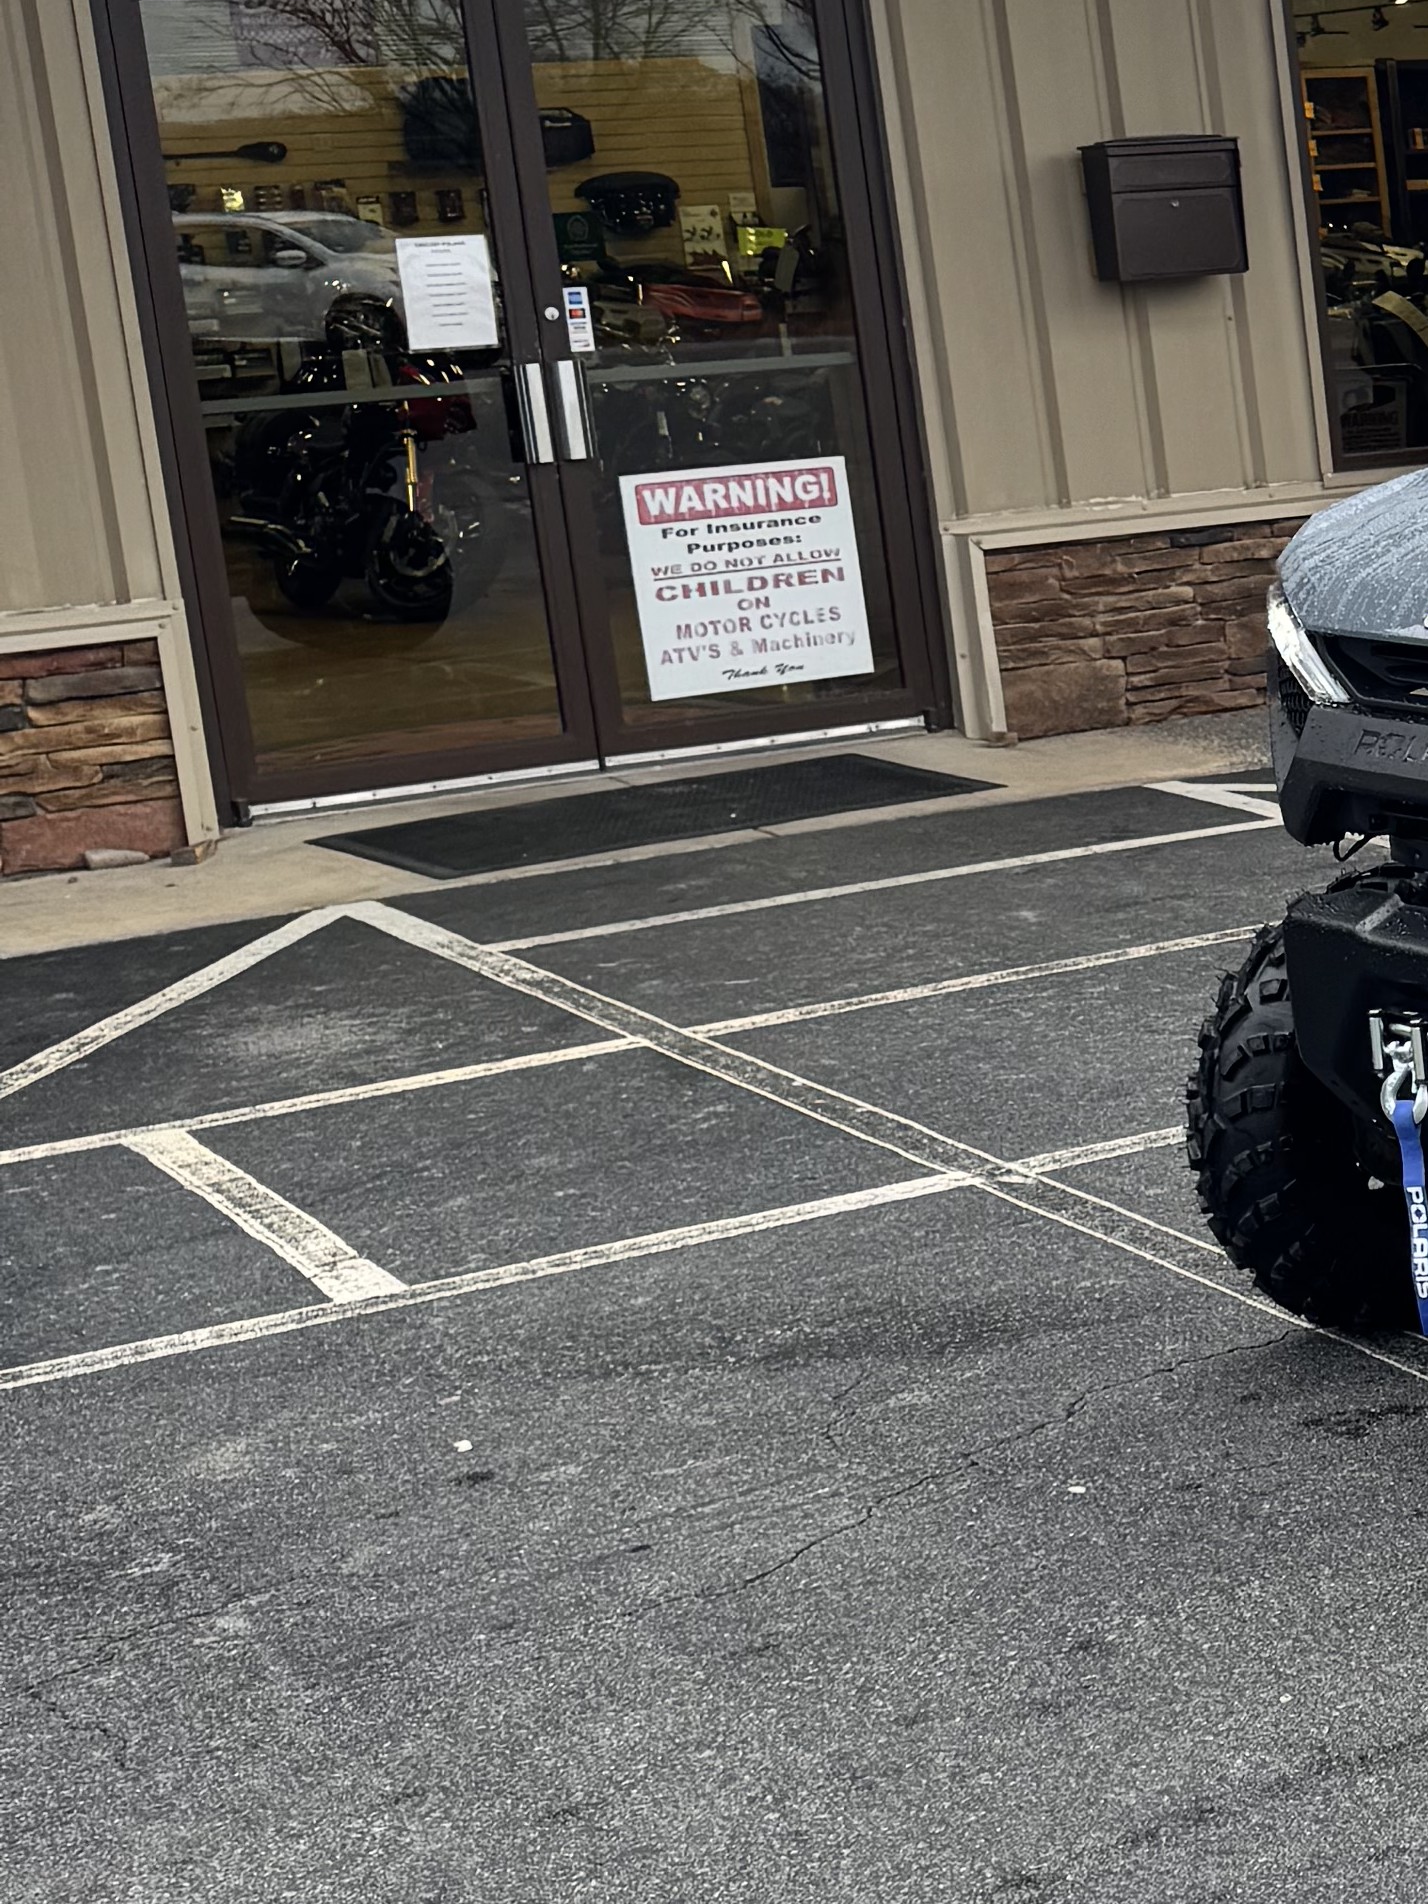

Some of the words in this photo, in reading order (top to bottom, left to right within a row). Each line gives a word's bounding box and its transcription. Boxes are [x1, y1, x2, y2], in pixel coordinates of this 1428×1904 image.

[643, 472, 830, 516] WARNING!
[661, 527, 698, 539] For
[707, 514, 821, 535] Insurance
[687, 533, 802, 554] Purposes:
[651, 563, 682, 577] WE
[691, 560, 717, 572] DO
[725, 555, 767, 569] NOT
[773, 547, 841, 564] ALLOW
[655, 567, 845, 601] CHILDREN
[737, 596, 770, 611] ON
[676, 616, 752, 640] MOTOR
[760, 606, 841, 630] CYCLES
[661, 644, 721, 666] ATV'S
[730, 641, 744, 657] &
[752, 630, 855, 655] Machinery
[722, 665, 769, 681] Thank
[775, 663, 804, 675] You
